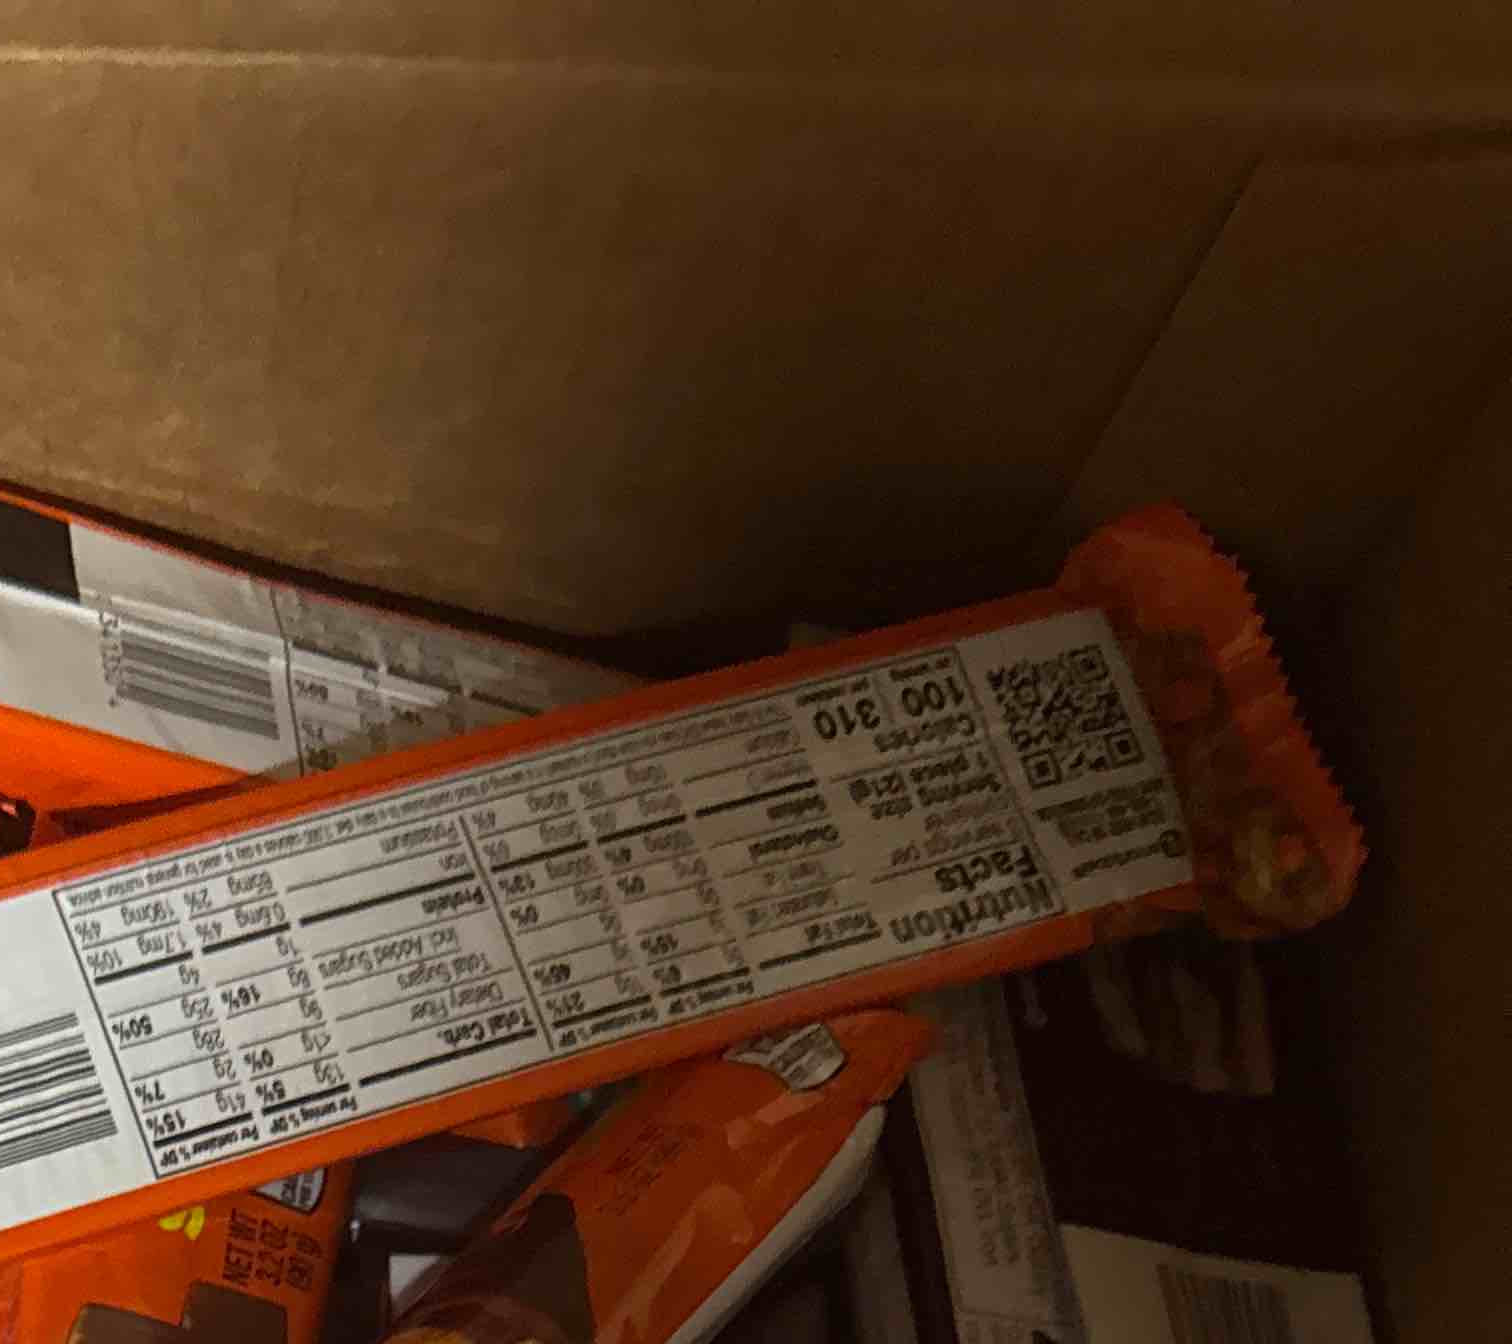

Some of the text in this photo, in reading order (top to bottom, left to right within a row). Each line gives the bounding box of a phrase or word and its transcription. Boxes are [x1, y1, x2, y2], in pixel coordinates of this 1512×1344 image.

[810, 673, 967, 744] 100 310
[932, 842, 1041, 900] Facts
[109, 1012, 153, 1044] 50%
[132, 1078, 164, 1106] 7%
[143, 1106, 187, 1137] 15%
